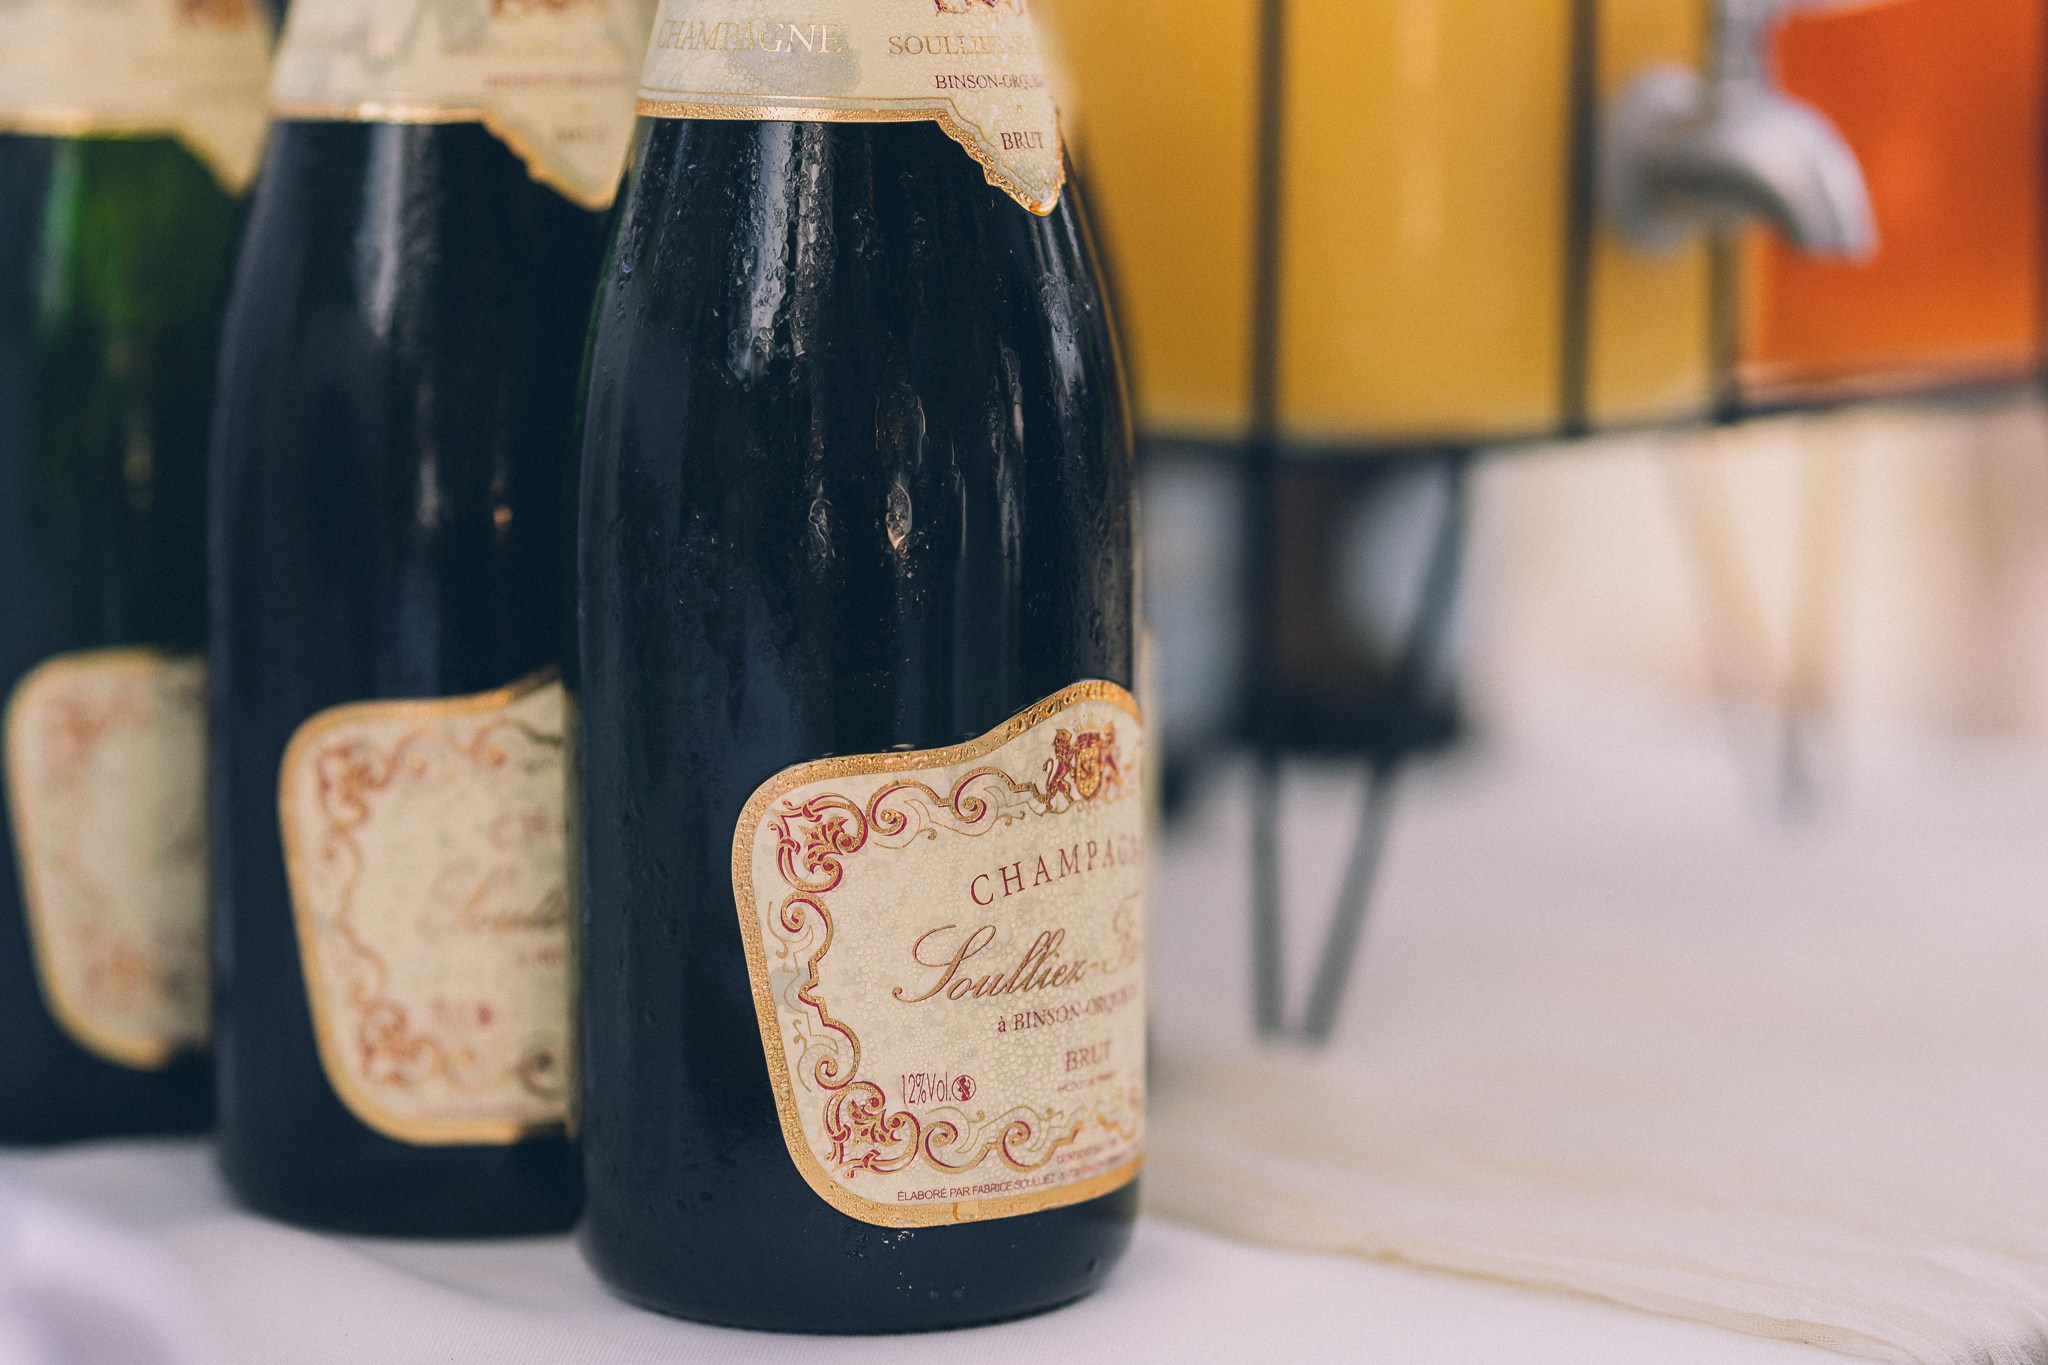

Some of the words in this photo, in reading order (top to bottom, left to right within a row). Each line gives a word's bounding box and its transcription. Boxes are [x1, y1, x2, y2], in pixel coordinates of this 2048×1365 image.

[657, 19, 842, 54] CHAMPAGNE
[1000, 131, 1045, 151] BRUT
[997, 1015, 1007, 1033] à
[1065, 1039, 1112, 1073] BRUT
[897, 1187, 948, 1202] ÉLABORÉ
[950, 1186, 971, 1198] PAR
[972, 1180, 1012, 1196] FABRICE
